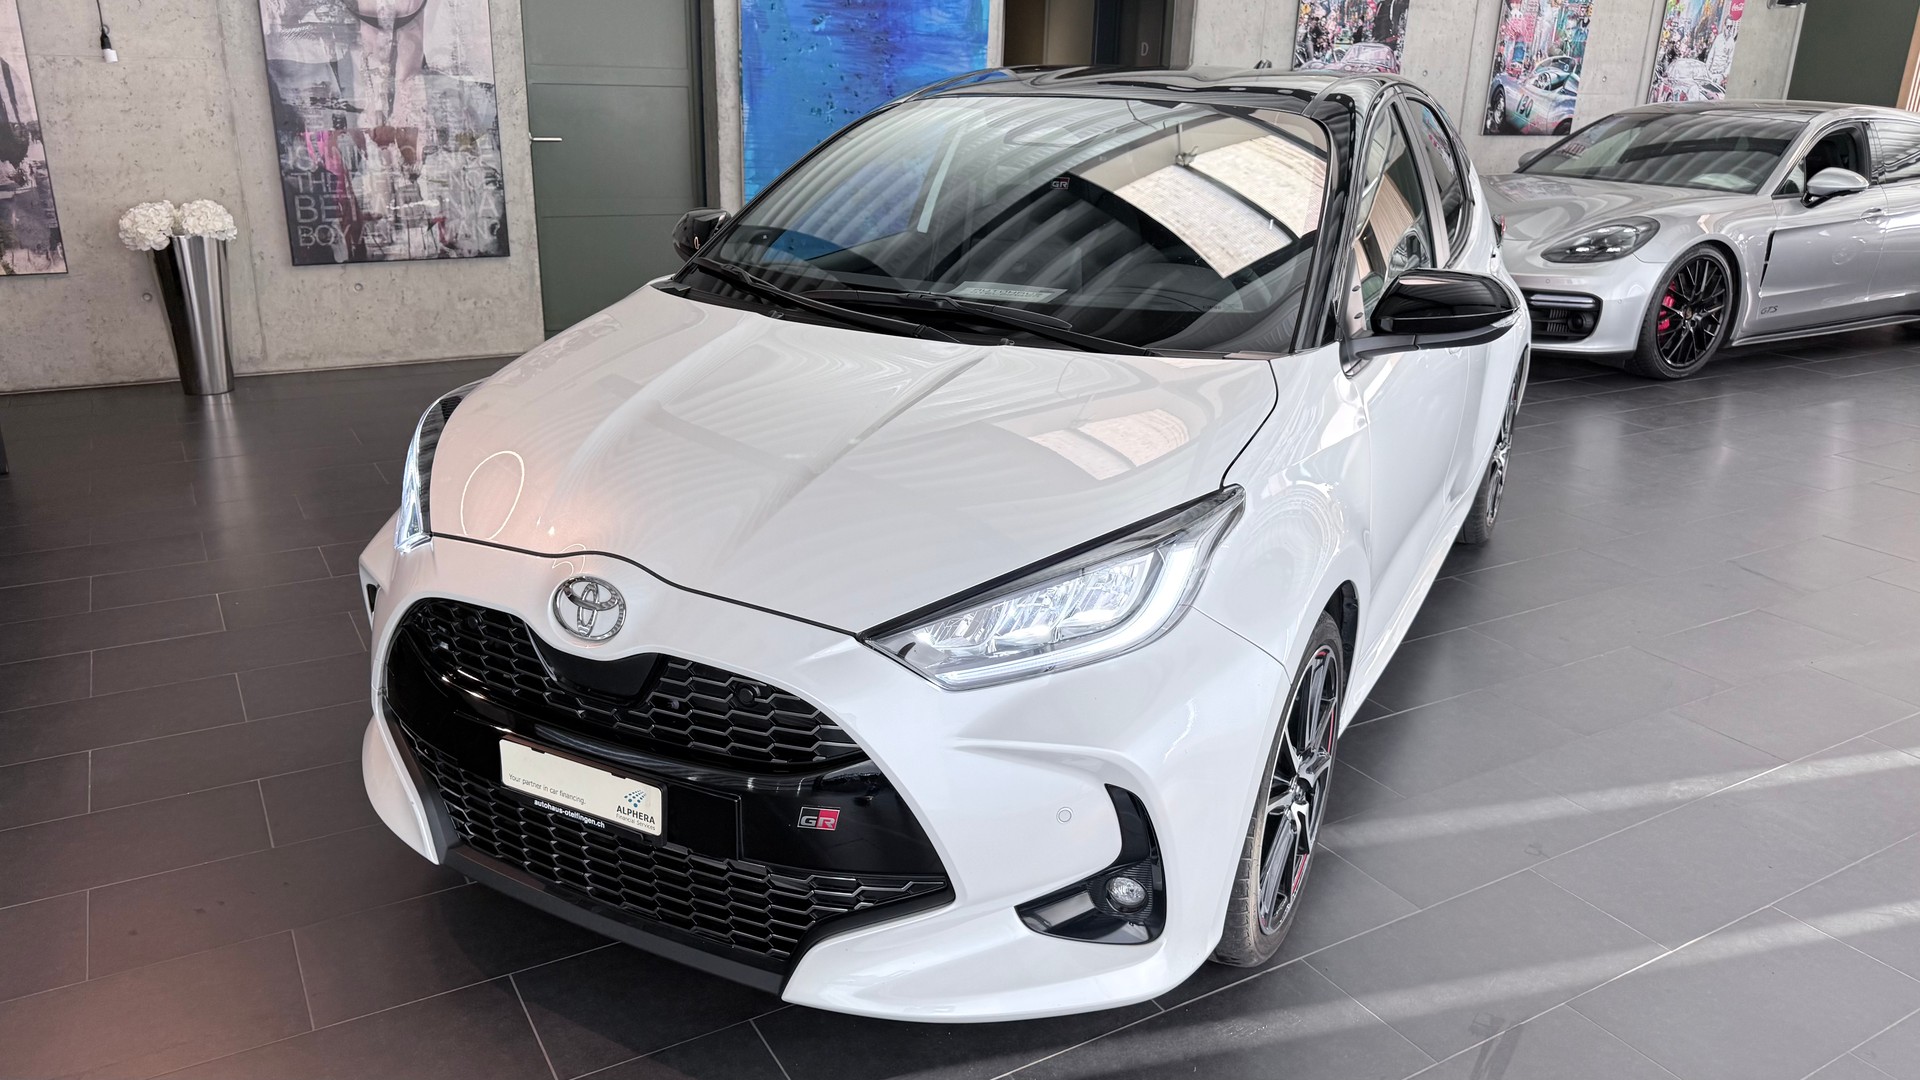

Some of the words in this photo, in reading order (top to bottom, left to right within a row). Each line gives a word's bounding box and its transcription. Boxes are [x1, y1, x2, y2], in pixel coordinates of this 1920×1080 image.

[1141, 41, 1149, 56] D
[291, 171, 344, 193] THE
[1052, 179, 1068, 189] GR
[298, 222, 352, 247] BOY
[1761, 304, 1778, 314] GTS
[509, 773, 522, 783] Your
[522, 777, 542, 791] partner
[543, 783, 549, 792] in
[615, 813, 635, 826] Financial
[636, 819, 656, 831] Services
[616, 805, 656, 825] ALPHERA
[800, 813, 836, 829] GR
